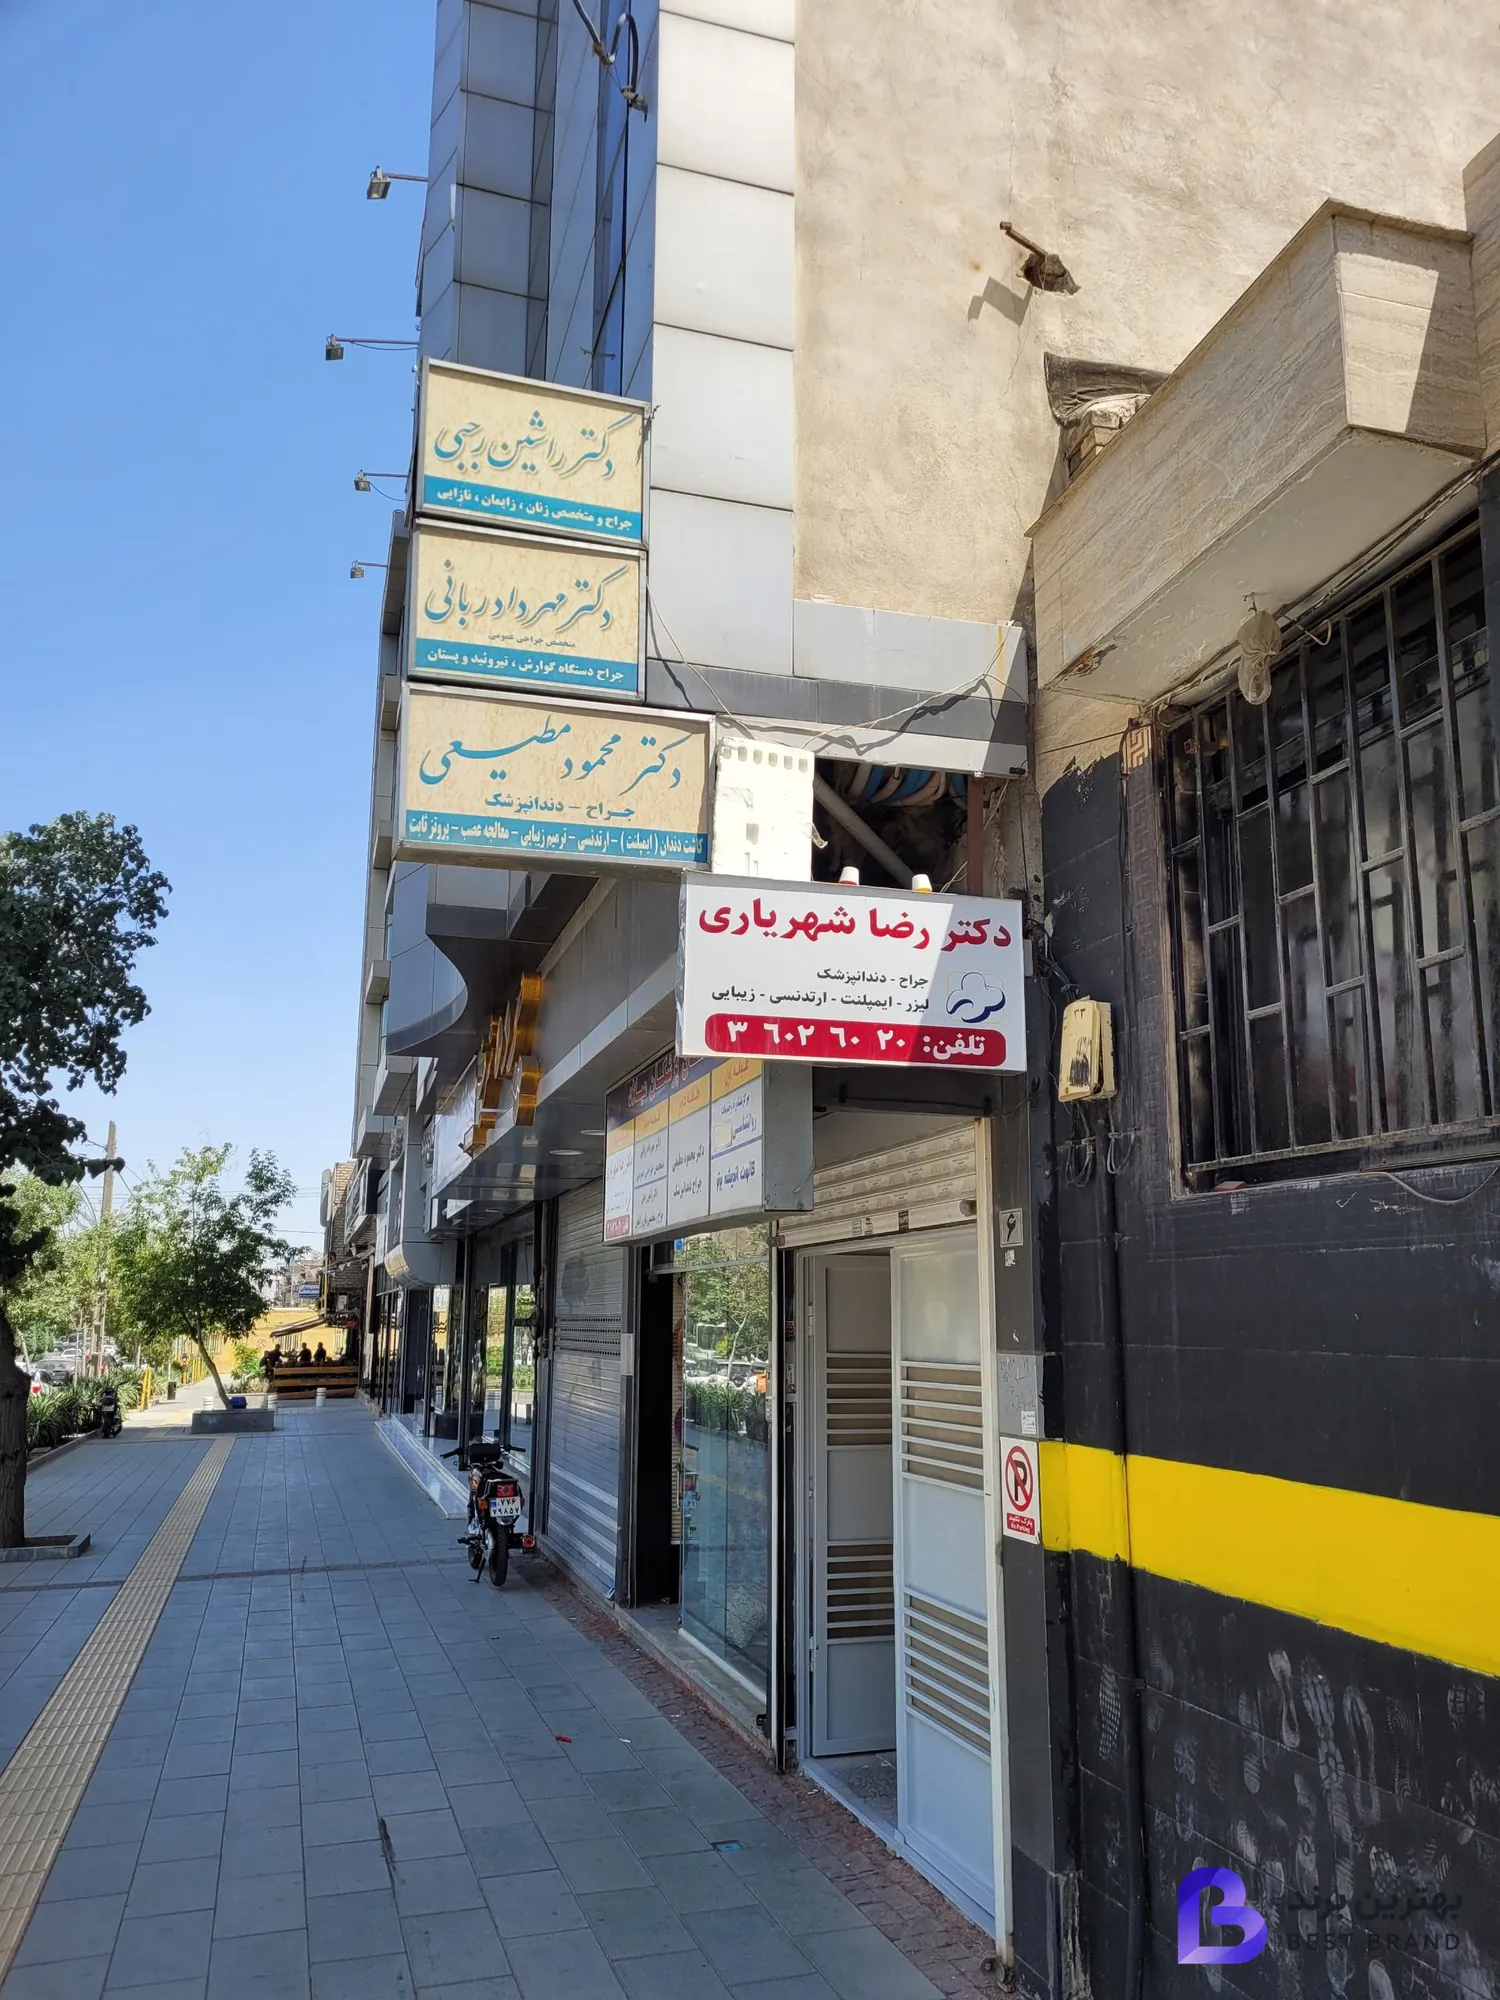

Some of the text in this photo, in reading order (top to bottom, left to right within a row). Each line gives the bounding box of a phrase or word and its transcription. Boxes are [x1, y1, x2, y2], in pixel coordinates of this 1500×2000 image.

[433, 420, 485, 473] رجبی
[560, 413, 634, 480] دکتر
[437, 489, 472, 504] نازایی
[480, 493, 517, 511] زایمان
[525, 499, 550, 517] زنان
[552, 505, 594, 522] متخصص
[595, 516, 603, 526] و
[605, 515, 633, 531] جراح
[424, 559, 629, 631] دکتر مهرداد ربانی
[488, 632, 515, 642] عمومی
[516, 636, 544, 648] جراحی
[427, 647, 461, 666] پستان
[462, 655, 469, 665] و
[471, 653, 509, 669] تیروئید
[518, 658, 556, 675] گوارش
[558, 663, 594, 678] دستگاه
[596, 667, 625, 683] جراح
[418, 714, 694, 797] دکتر محمود مطیعی
[484, 793, 565, 817] دندانپزشک
[586, 802, 635, 822] جراح
[409, 816, 428, 834] ثابت
[460, 825, 484, 840] عصب
[485, 823, 510, 841] معالجه
[520, 826, 546, 848] زیبایی
[545, 828, 567, 850] ترمیم
[577, 831, 610, 852] ارتدنسی
[660, 838, 682, 856] دندان
[683, 839, 704, 855] کاشت
[698, 897, 1012, 953] دکتر رضا شهریاری
[816, 968, 887, 986] دندانپزشک
[898, 975, 929, 990] جراح
[711, 986, 758, 1002] زیبایی
[768, 991, 828, 1006] ارتدنسی
[839, 995, 893, 1011] ایمپلنت
[906, 997, 930, 1013] لیزر
[726, 1020, 748, 1043] ۳
[876, 1029, 906, 1051] ۲۰
[922, 1035, 986, 1060] تلفن:
